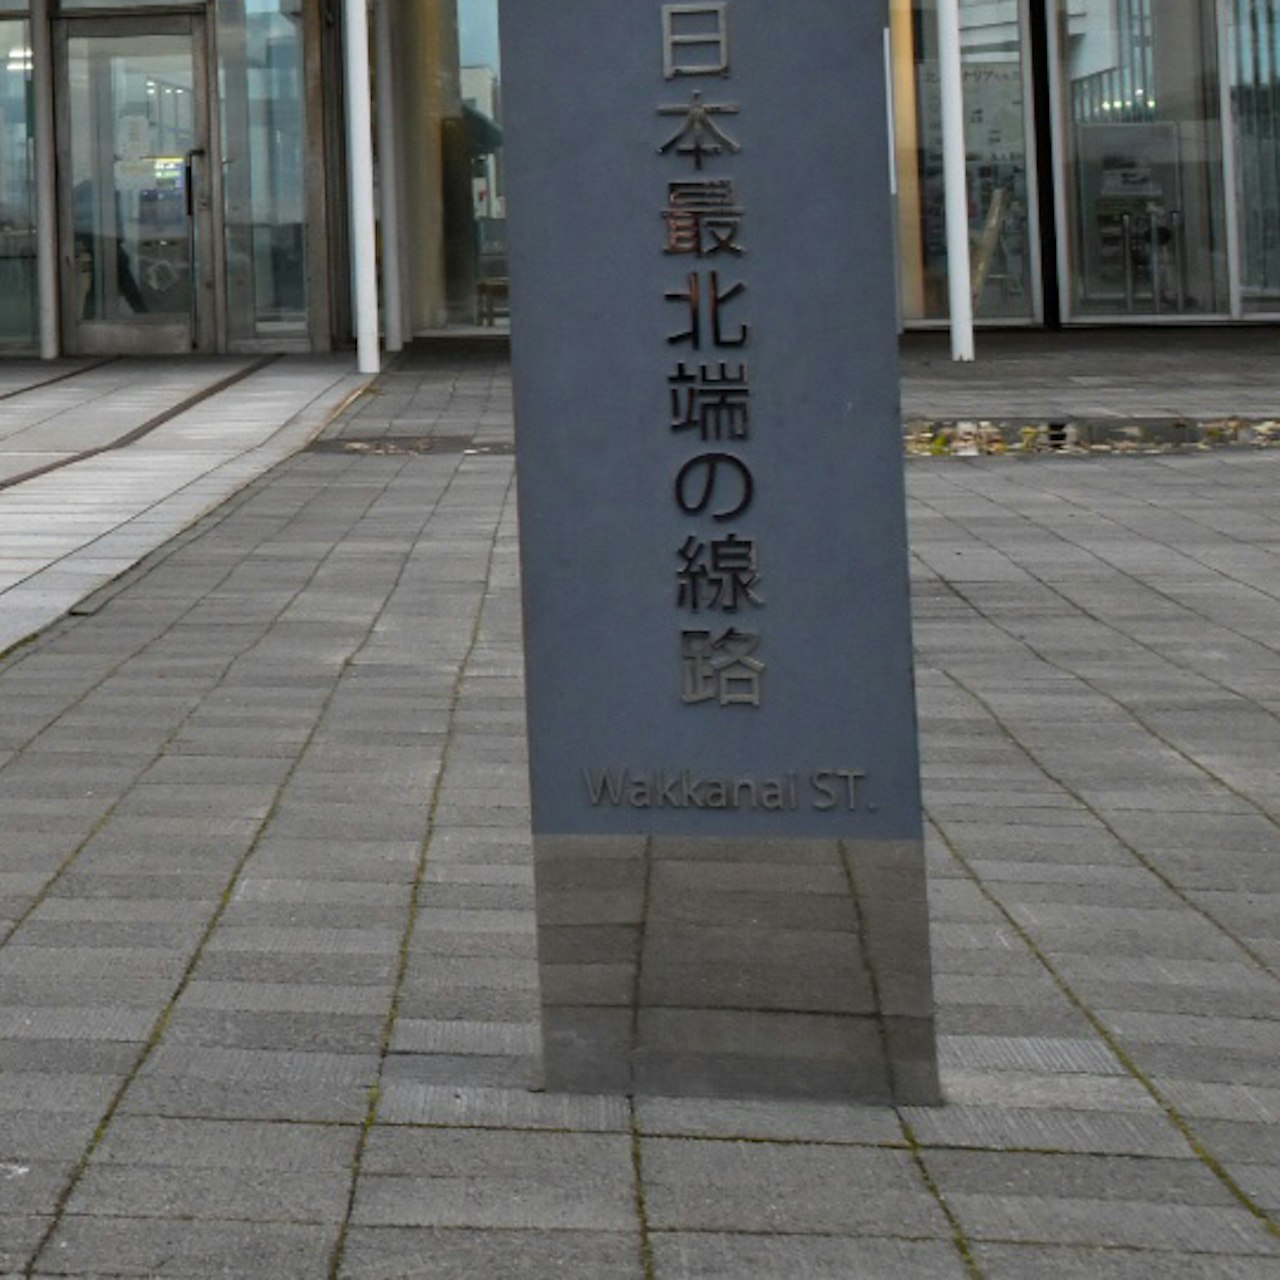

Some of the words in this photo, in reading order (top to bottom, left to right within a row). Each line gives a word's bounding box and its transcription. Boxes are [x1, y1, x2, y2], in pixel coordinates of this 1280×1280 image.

[655, 1, 768, 708] 日本最北端の線路
[581, 766, 801, 811] Wakkanai
[811, 769, 879, 813] ST.
